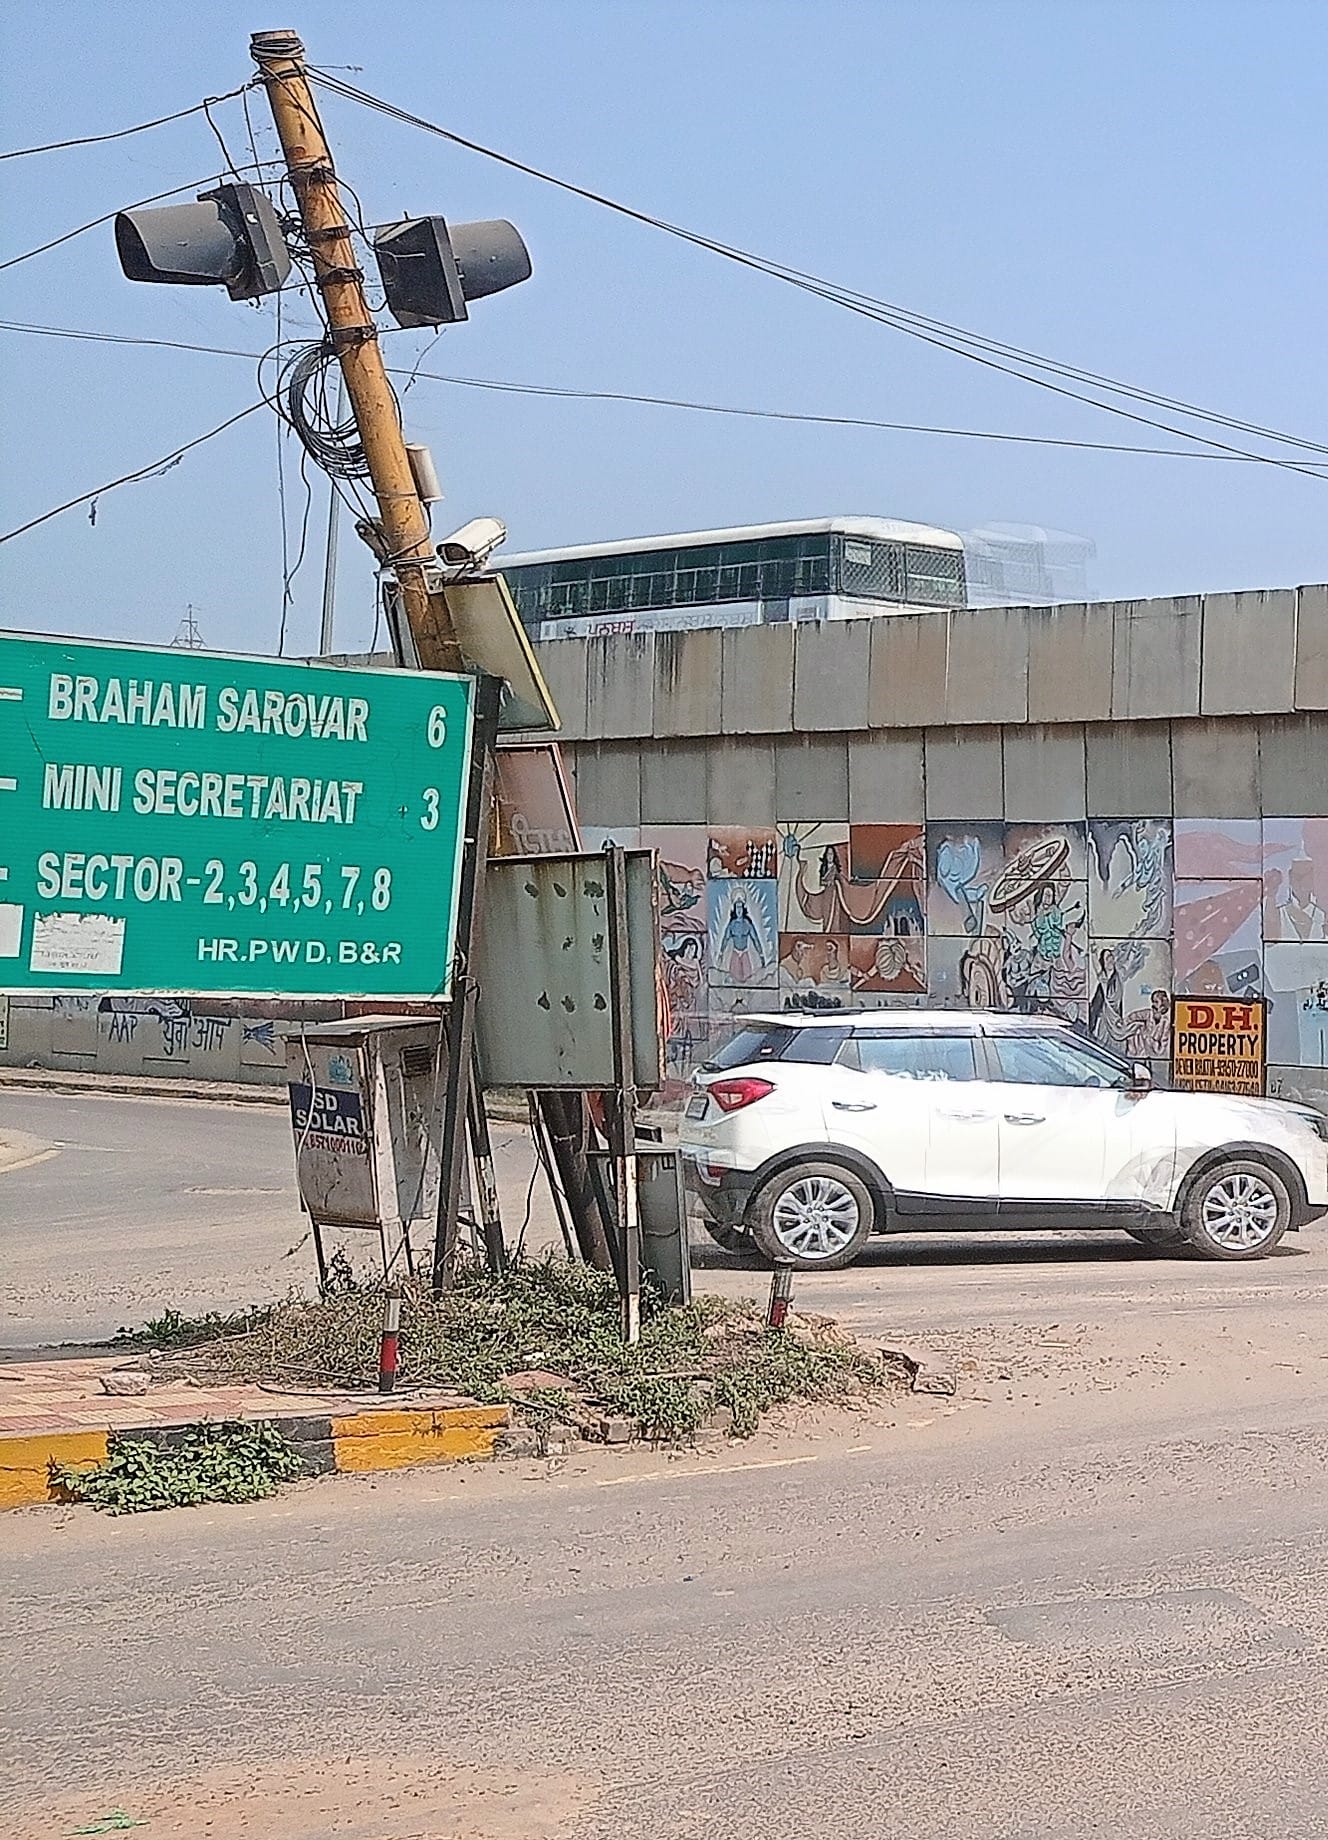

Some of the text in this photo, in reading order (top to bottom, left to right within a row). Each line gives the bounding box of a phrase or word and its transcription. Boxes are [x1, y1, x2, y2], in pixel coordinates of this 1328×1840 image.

[48, 673, 448, 749] BRAHAM SAROVAR 6
[42, 763, 441, 831] MINI SECRETARIAT 3
[108, 1012, 138, 1043] AAP
[1187, 1005, 1259, 1030] D.H.
[1178, 1032, 1259, 1056] PROPERTY
[314, 1092, 338, 1111] SD
[296, 1109, 361, 1135] SOLAR
